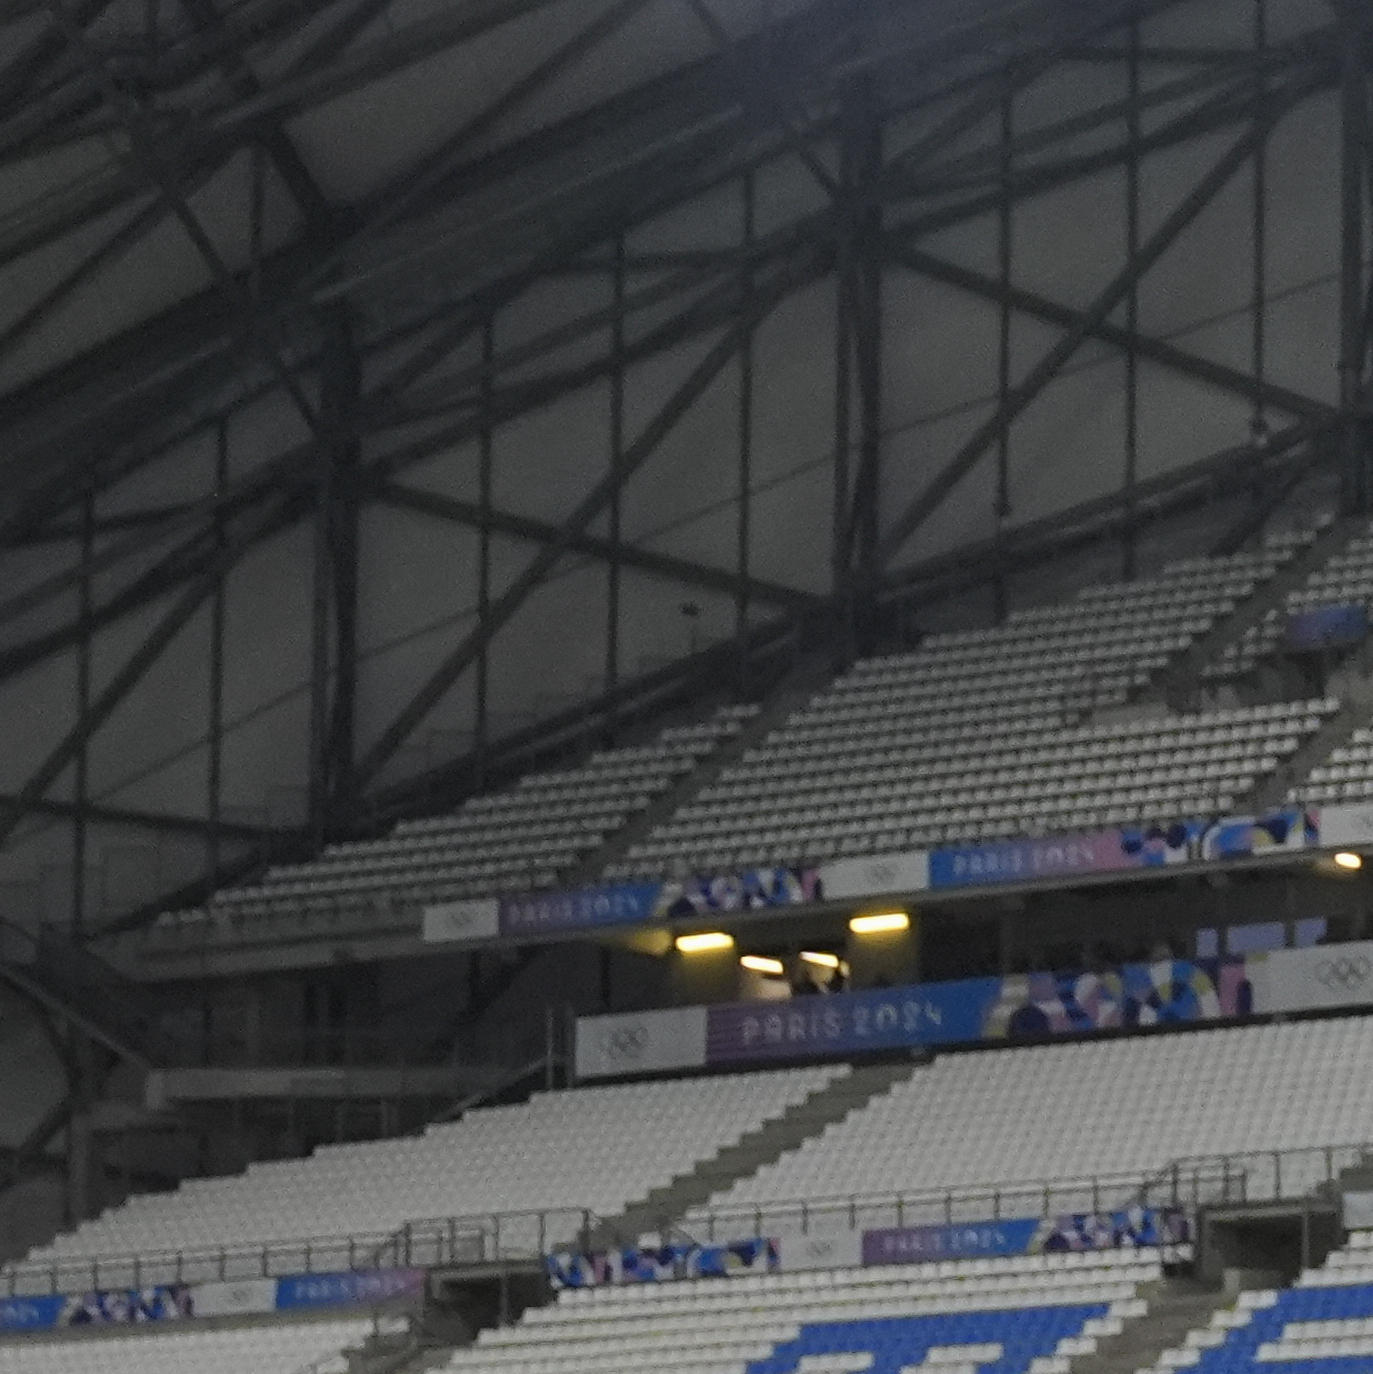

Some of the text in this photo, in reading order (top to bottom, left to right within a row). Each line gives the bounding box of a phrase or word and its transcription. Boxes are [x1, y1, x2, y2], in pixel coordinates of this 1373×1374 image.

[952, 843, 1095, 876] PARIS 2024
[741, 1000, 943, 1045] PARIS 2024
